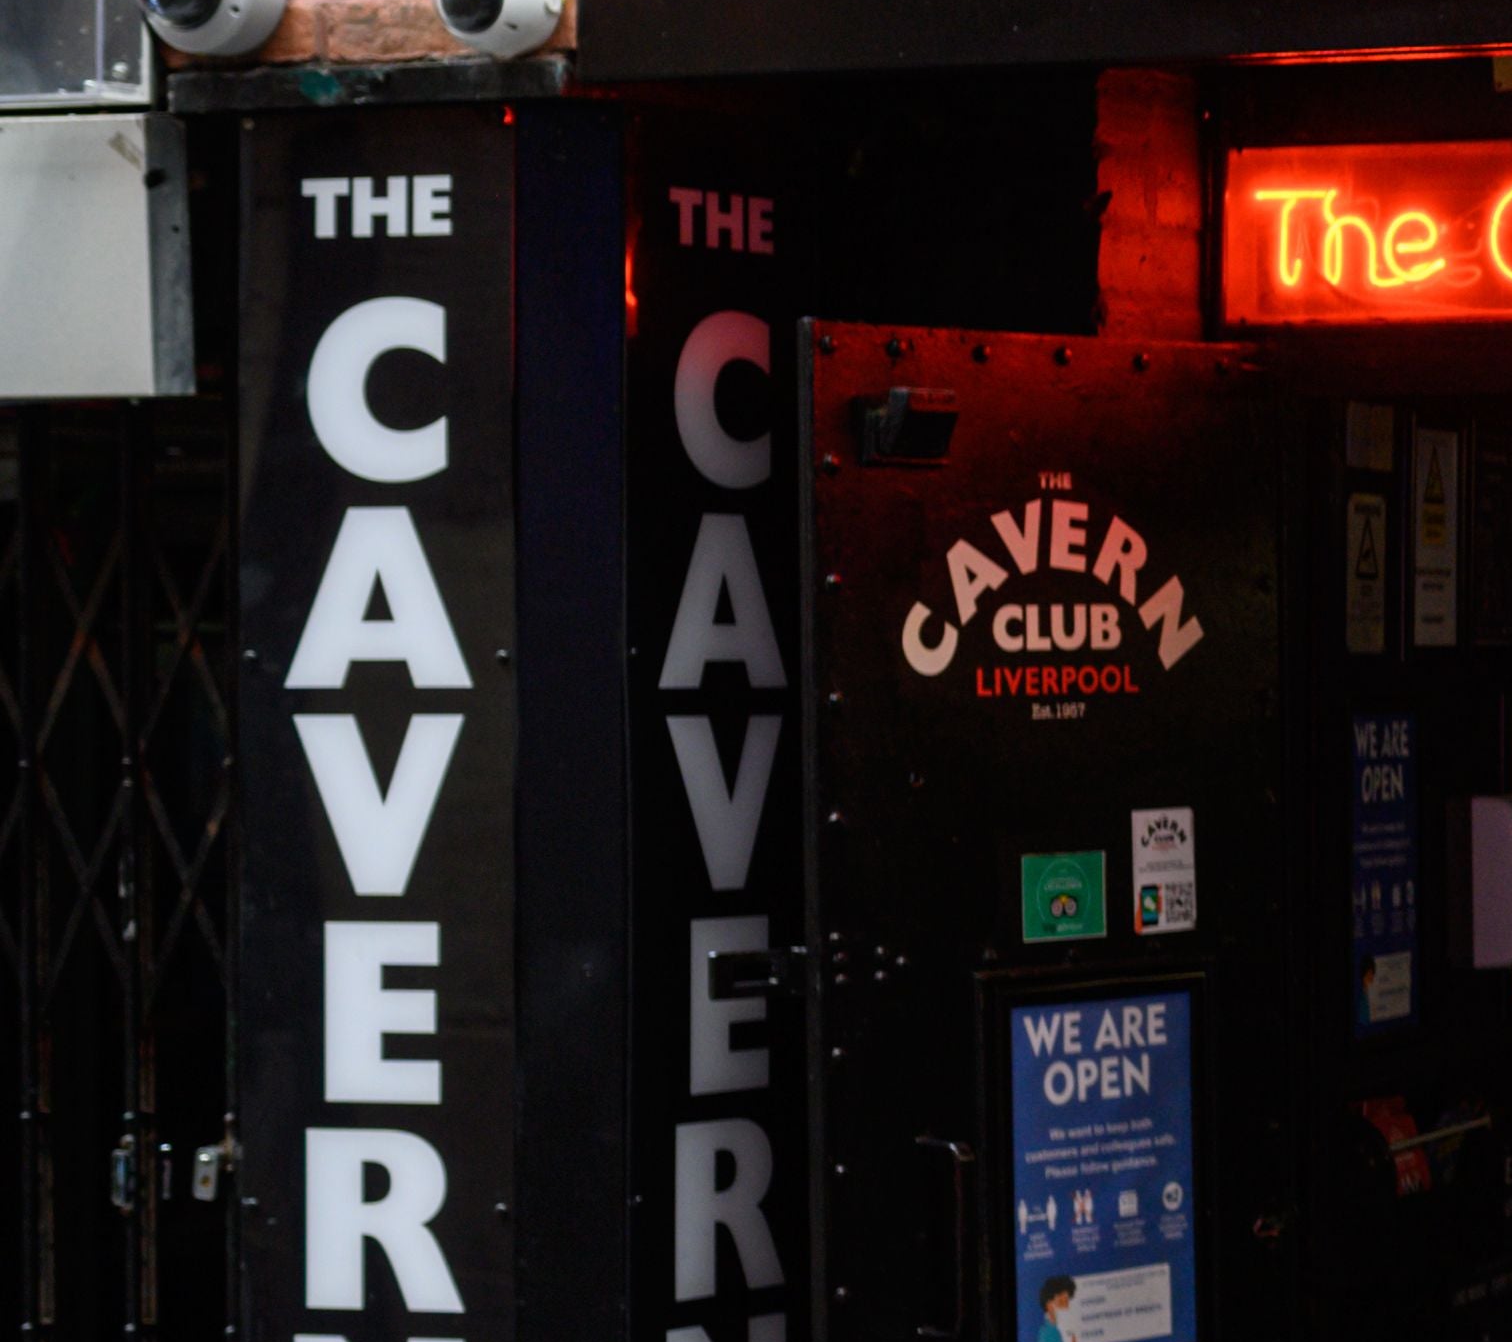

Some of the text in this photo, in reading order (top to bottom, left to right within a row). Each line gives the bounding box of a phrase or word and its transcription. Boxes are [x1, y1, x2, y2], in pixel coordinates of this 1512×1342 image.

[302, 174, 453, 239] THE
[668, 185, 776, 254] THE
[1254, 187, 1445, 287] The
[1039, 472, 1072, 490] THE
[902, 498, 1204, 677] CAVERN
[992, 604, 1122, 652] CLUB
[976, 665, 1140, 697] LIVERPOOL
[1023, 1003, 1168, 1058] WE ARE
[1043, 1053, 1151, 1106] OPEN
